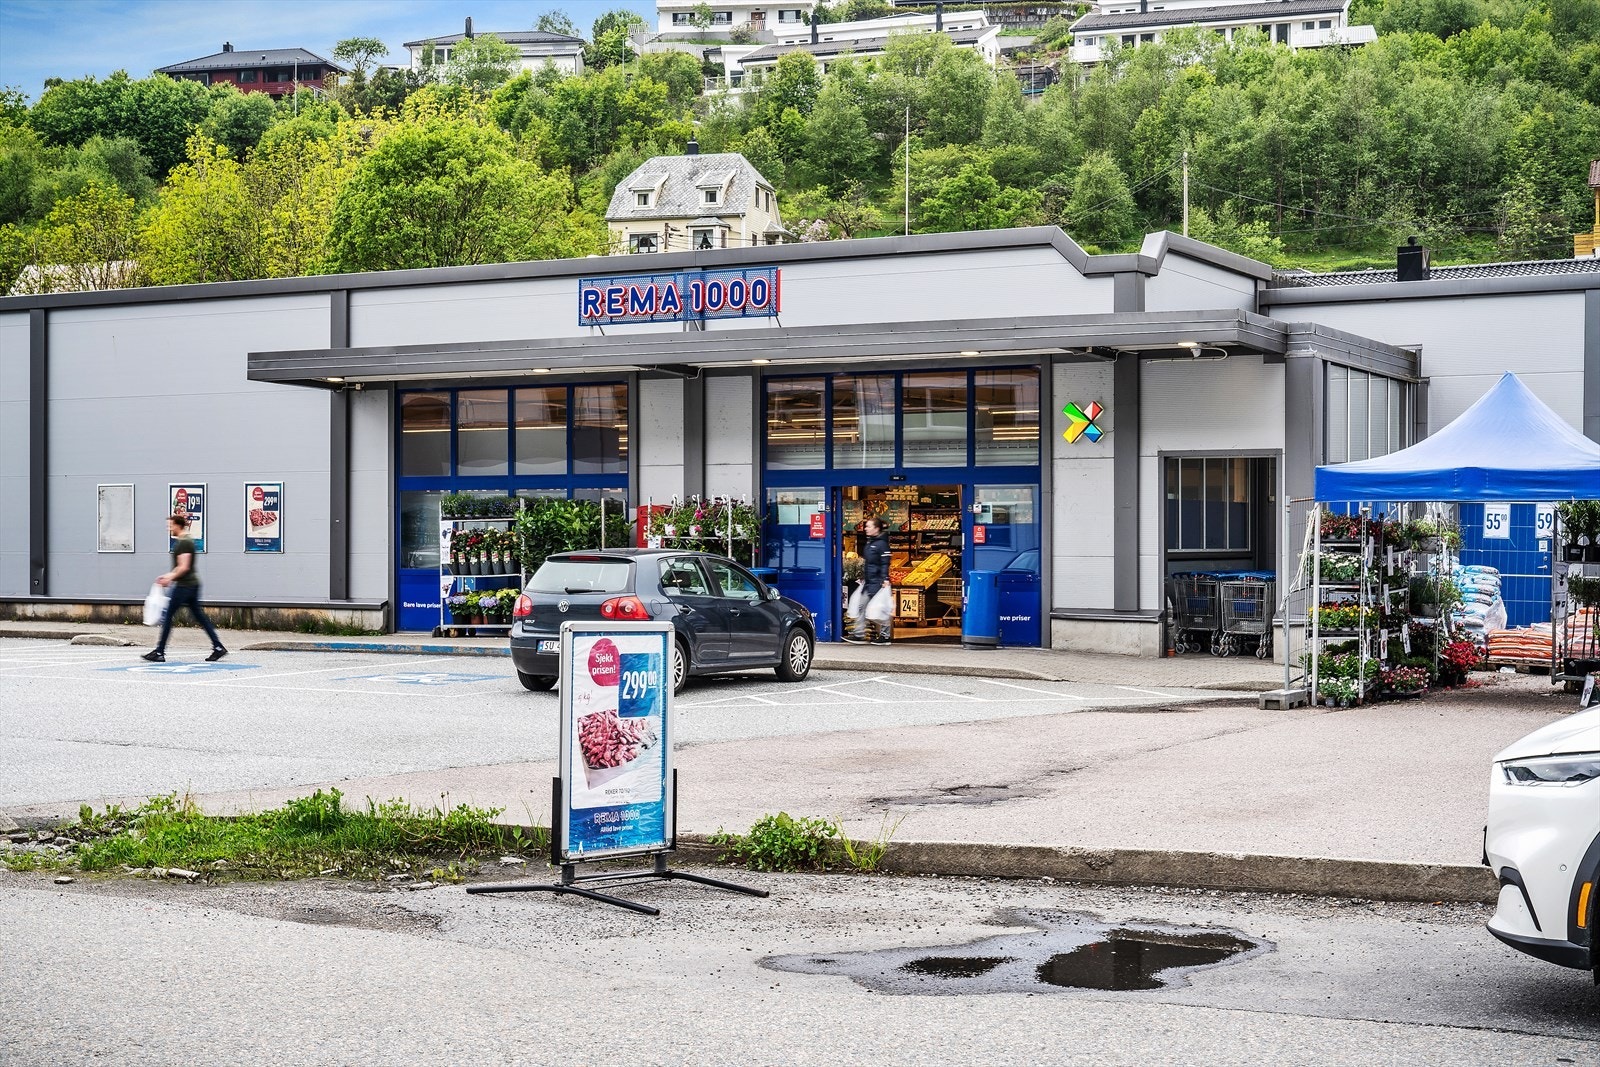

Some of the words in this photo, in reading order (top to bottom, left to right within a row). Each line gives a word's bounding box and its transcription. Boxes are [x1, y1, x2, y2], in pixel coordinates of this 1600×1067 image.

[582, 282, 682, 318] REMA
[690, 277, 771, 312] 1000
[1011, 614, 1031, 622] priser
[544, 641, 555, 650] SU
[595, 653, 613, 665] Sjekk
[592, 664, 615, 675] prisen!
[594, 812, 619, 824] REMA
